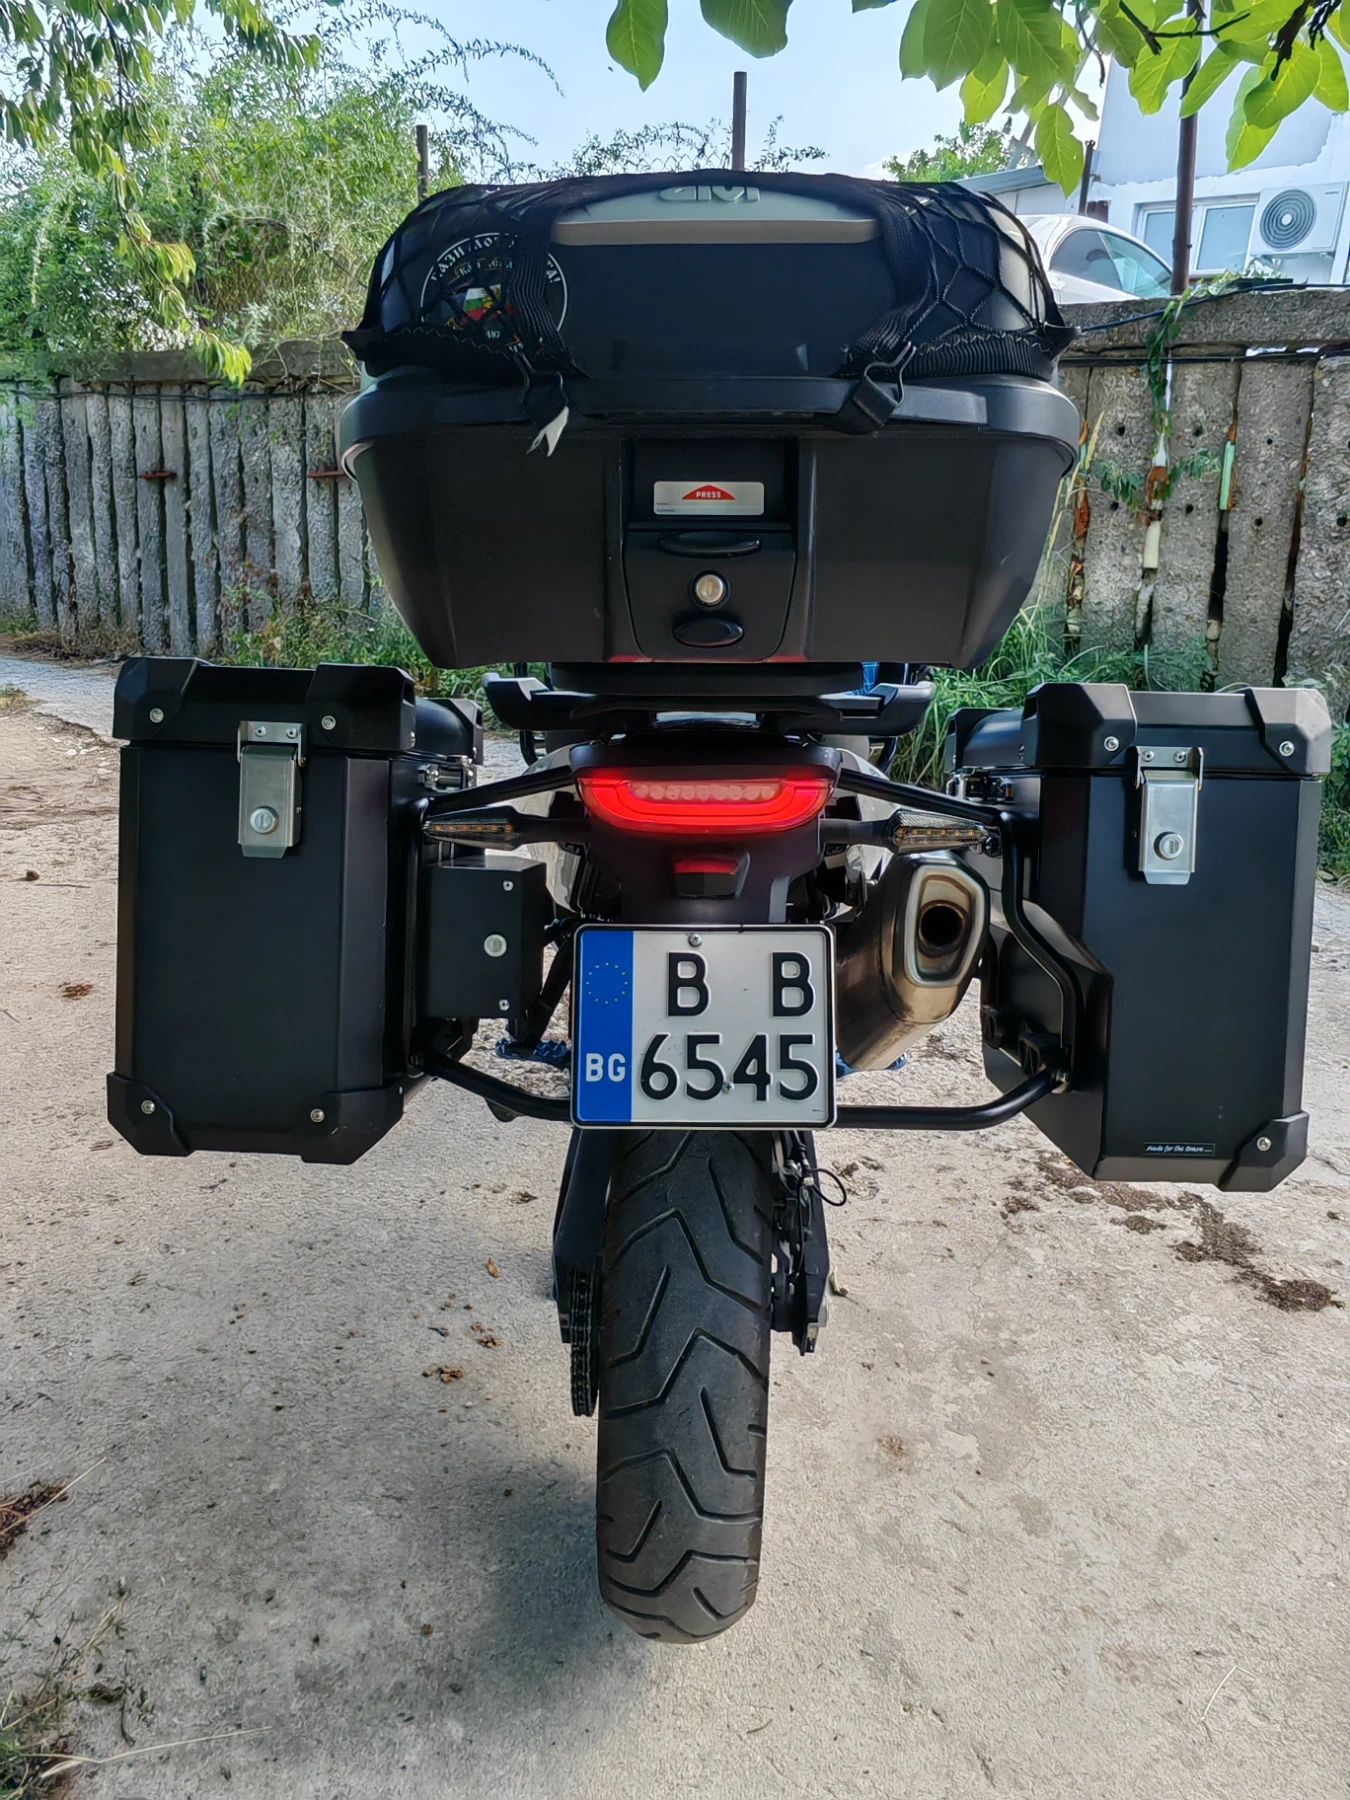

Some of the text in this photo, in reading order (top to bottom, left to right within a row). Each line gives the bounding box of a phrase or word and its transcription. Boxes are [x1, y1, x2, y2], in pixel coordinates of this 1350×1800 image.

[696, 491, 721, 499] PRESS
[667, 951, 815, 1018] B B
[585, 1053, 627, 1083] BG
[639, 1032, 820, 1102] 6545
[1164, 1145, 1174, 1153] for
